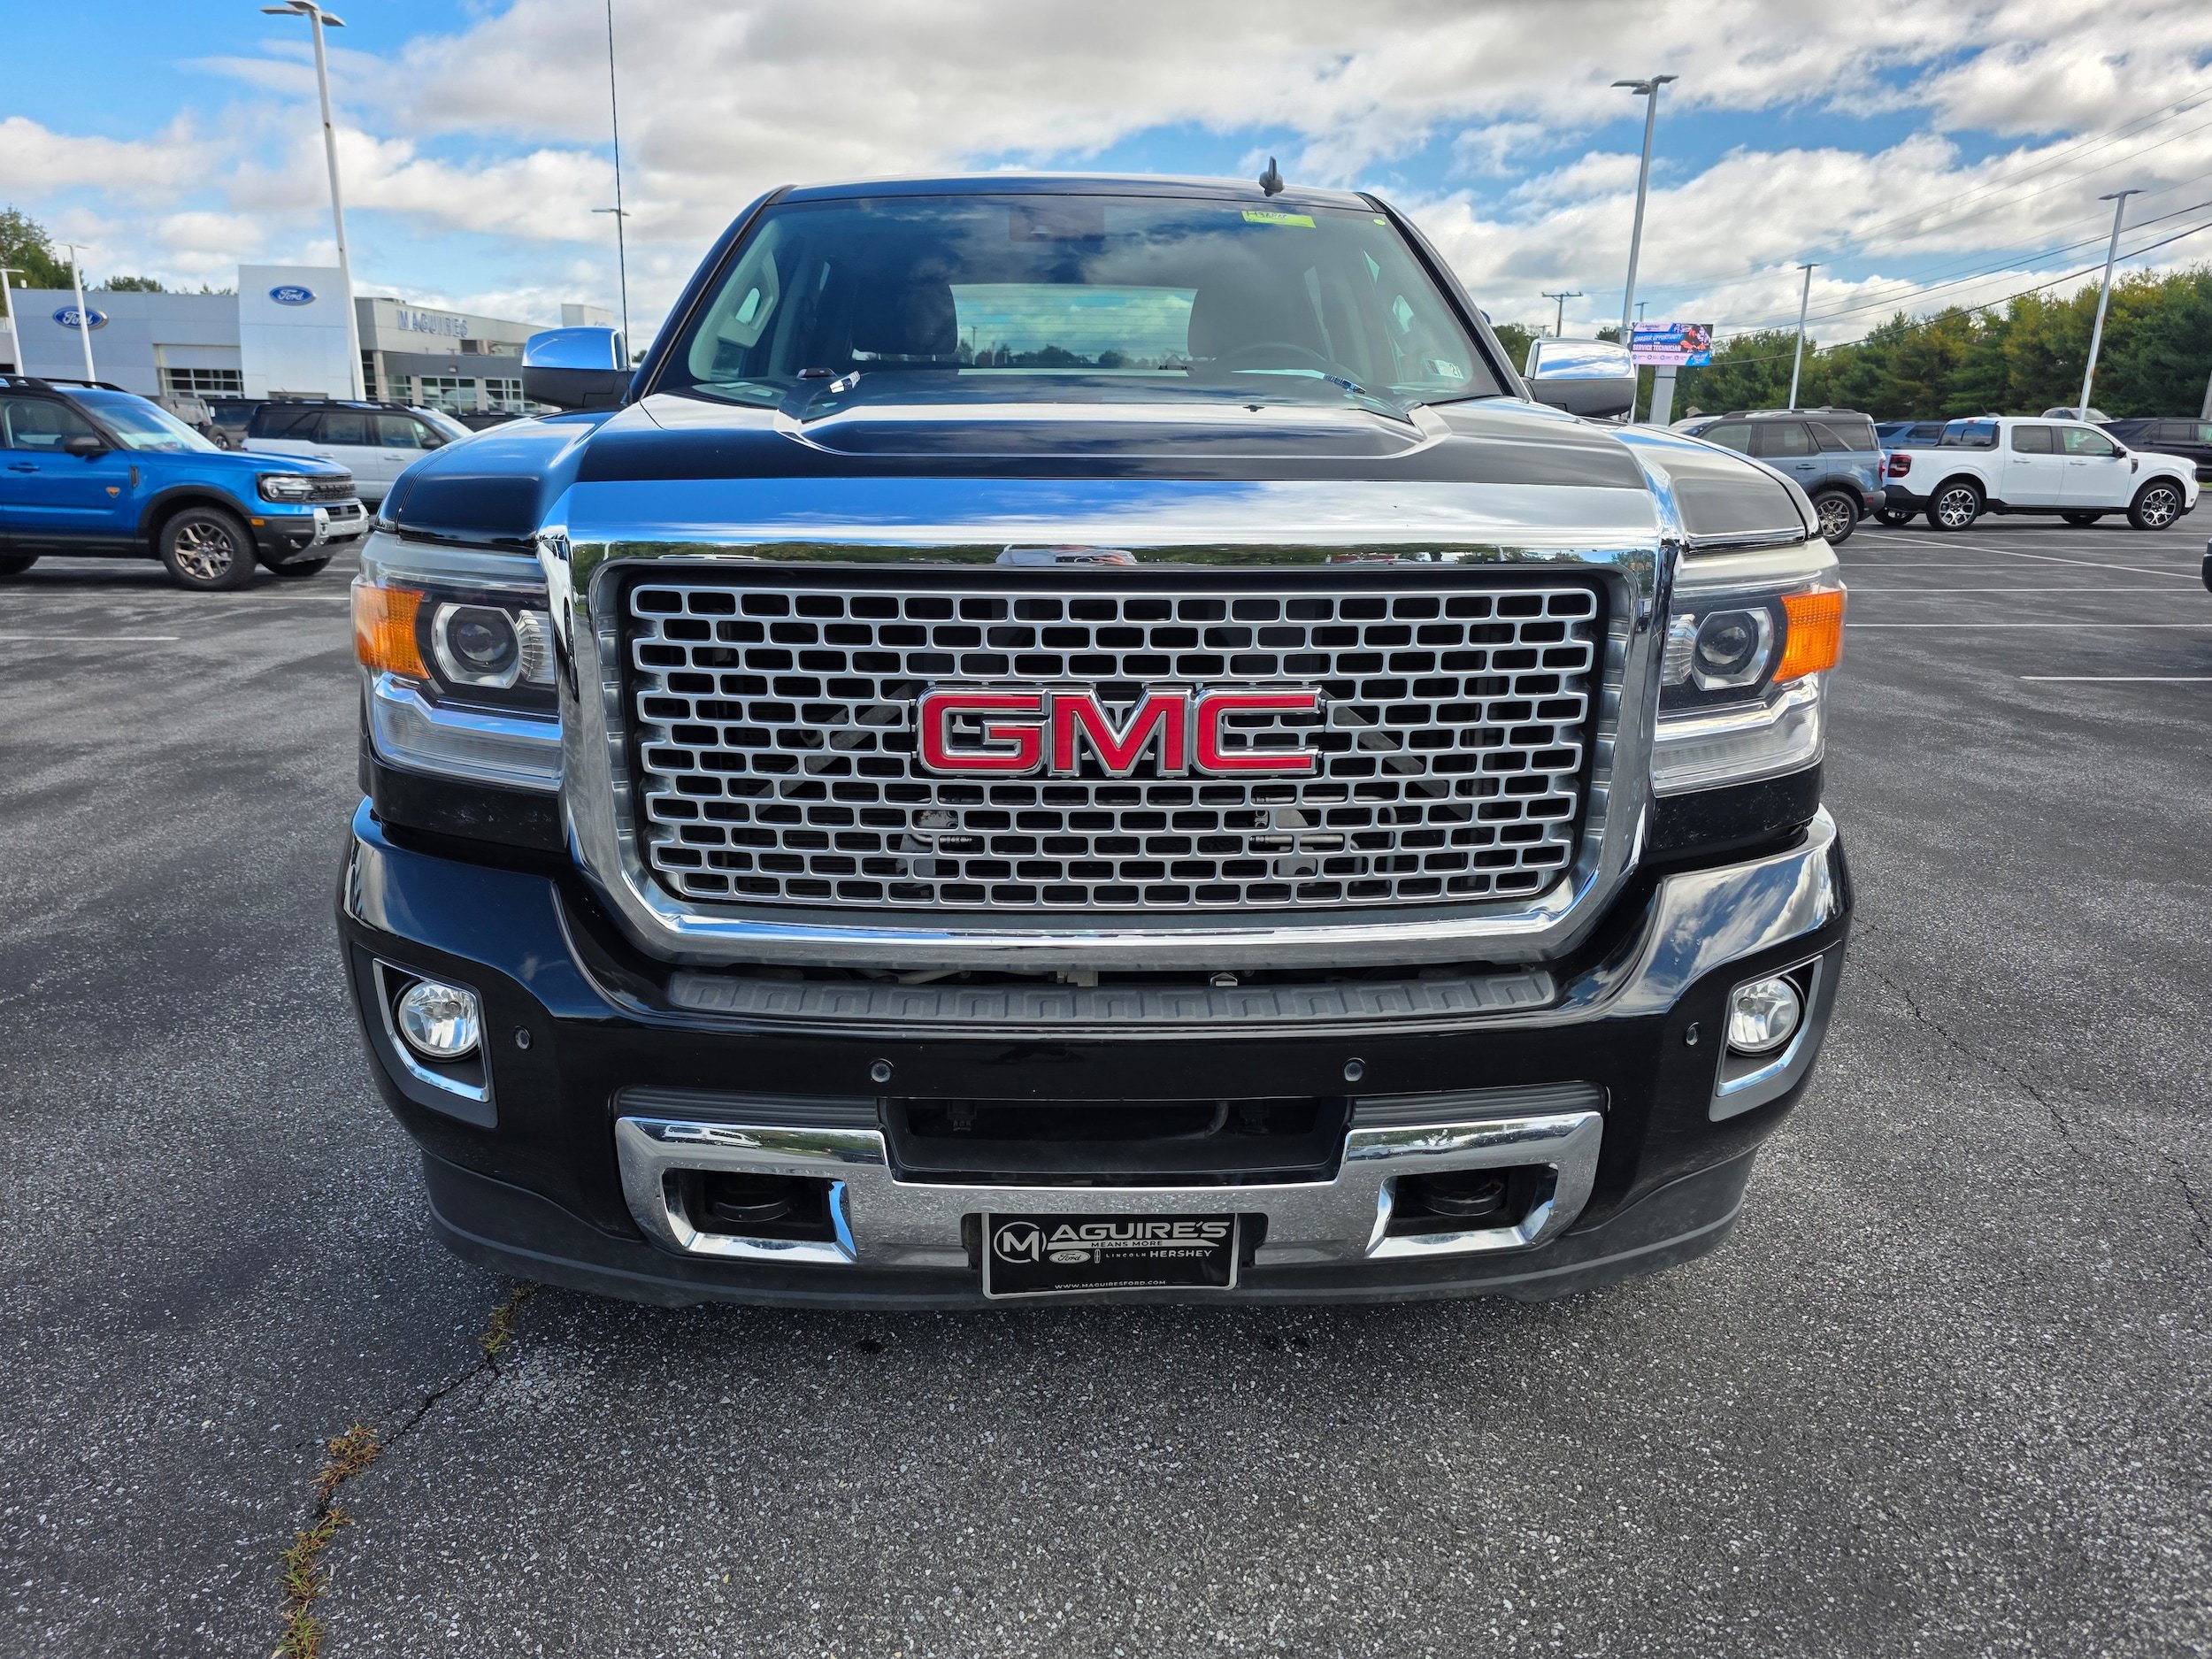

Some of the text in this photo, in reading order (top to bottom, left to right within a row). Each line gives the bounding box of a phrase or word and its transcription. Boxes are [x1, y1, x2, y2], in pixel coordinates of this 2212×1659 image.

[278, 289, 304, 301] Ford
[396, 310, 468, 338] MAGUIRES
[918, 686, 1324, 777] GMC
[1150, 1249, 1212, 1258] HERSHEY
[1055, 1279, 1166, 1289] WWW.MAGUIRESFORD.COM
